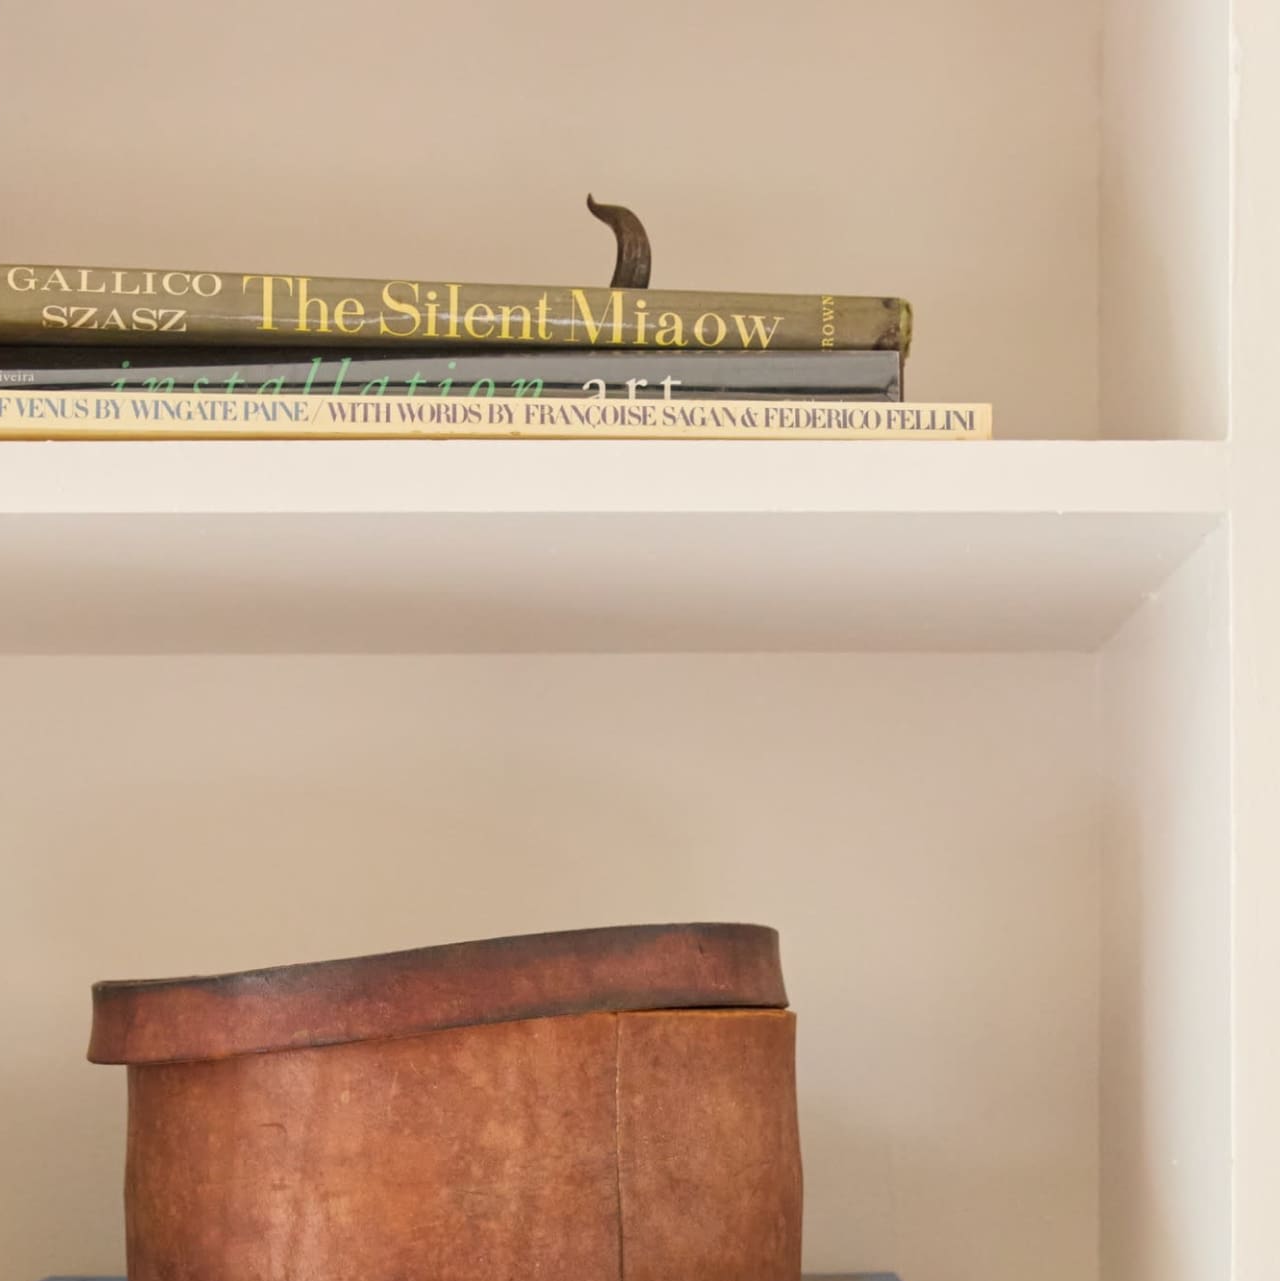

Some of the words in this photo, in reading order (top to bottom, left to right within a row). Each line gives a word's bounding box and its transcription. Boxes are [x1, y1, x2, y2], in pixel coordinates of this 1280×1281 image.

[7, 266, 222, 298] GALLICO
[42, 305, 187, 333] SZASZ
[242, 275, 366, 333] The
[380, 280, 554, 341] Silent
[564, 288, 785, 349] Miaow
[821, 295, 835, 350] ROWN
[11, 397, 89, 419] VENUS
[94, 398, 127, 420] BY
[132, 400, 238, 421] WINGATE
[243, 400, 309, 422] PAINE
[327, 402, 391, 423] WITH
[396, 402, 483, 424] WORDS
[488, 403, 515, 424] BY
[524, 404, 657, 429] FRANÇOISE
[662, 406, 738, 428] SAGAN
[740, 407, 759, 429] &
[764, 407, 882, 430] FEDERICO
[886, 409, 975, 431] FELLINI
